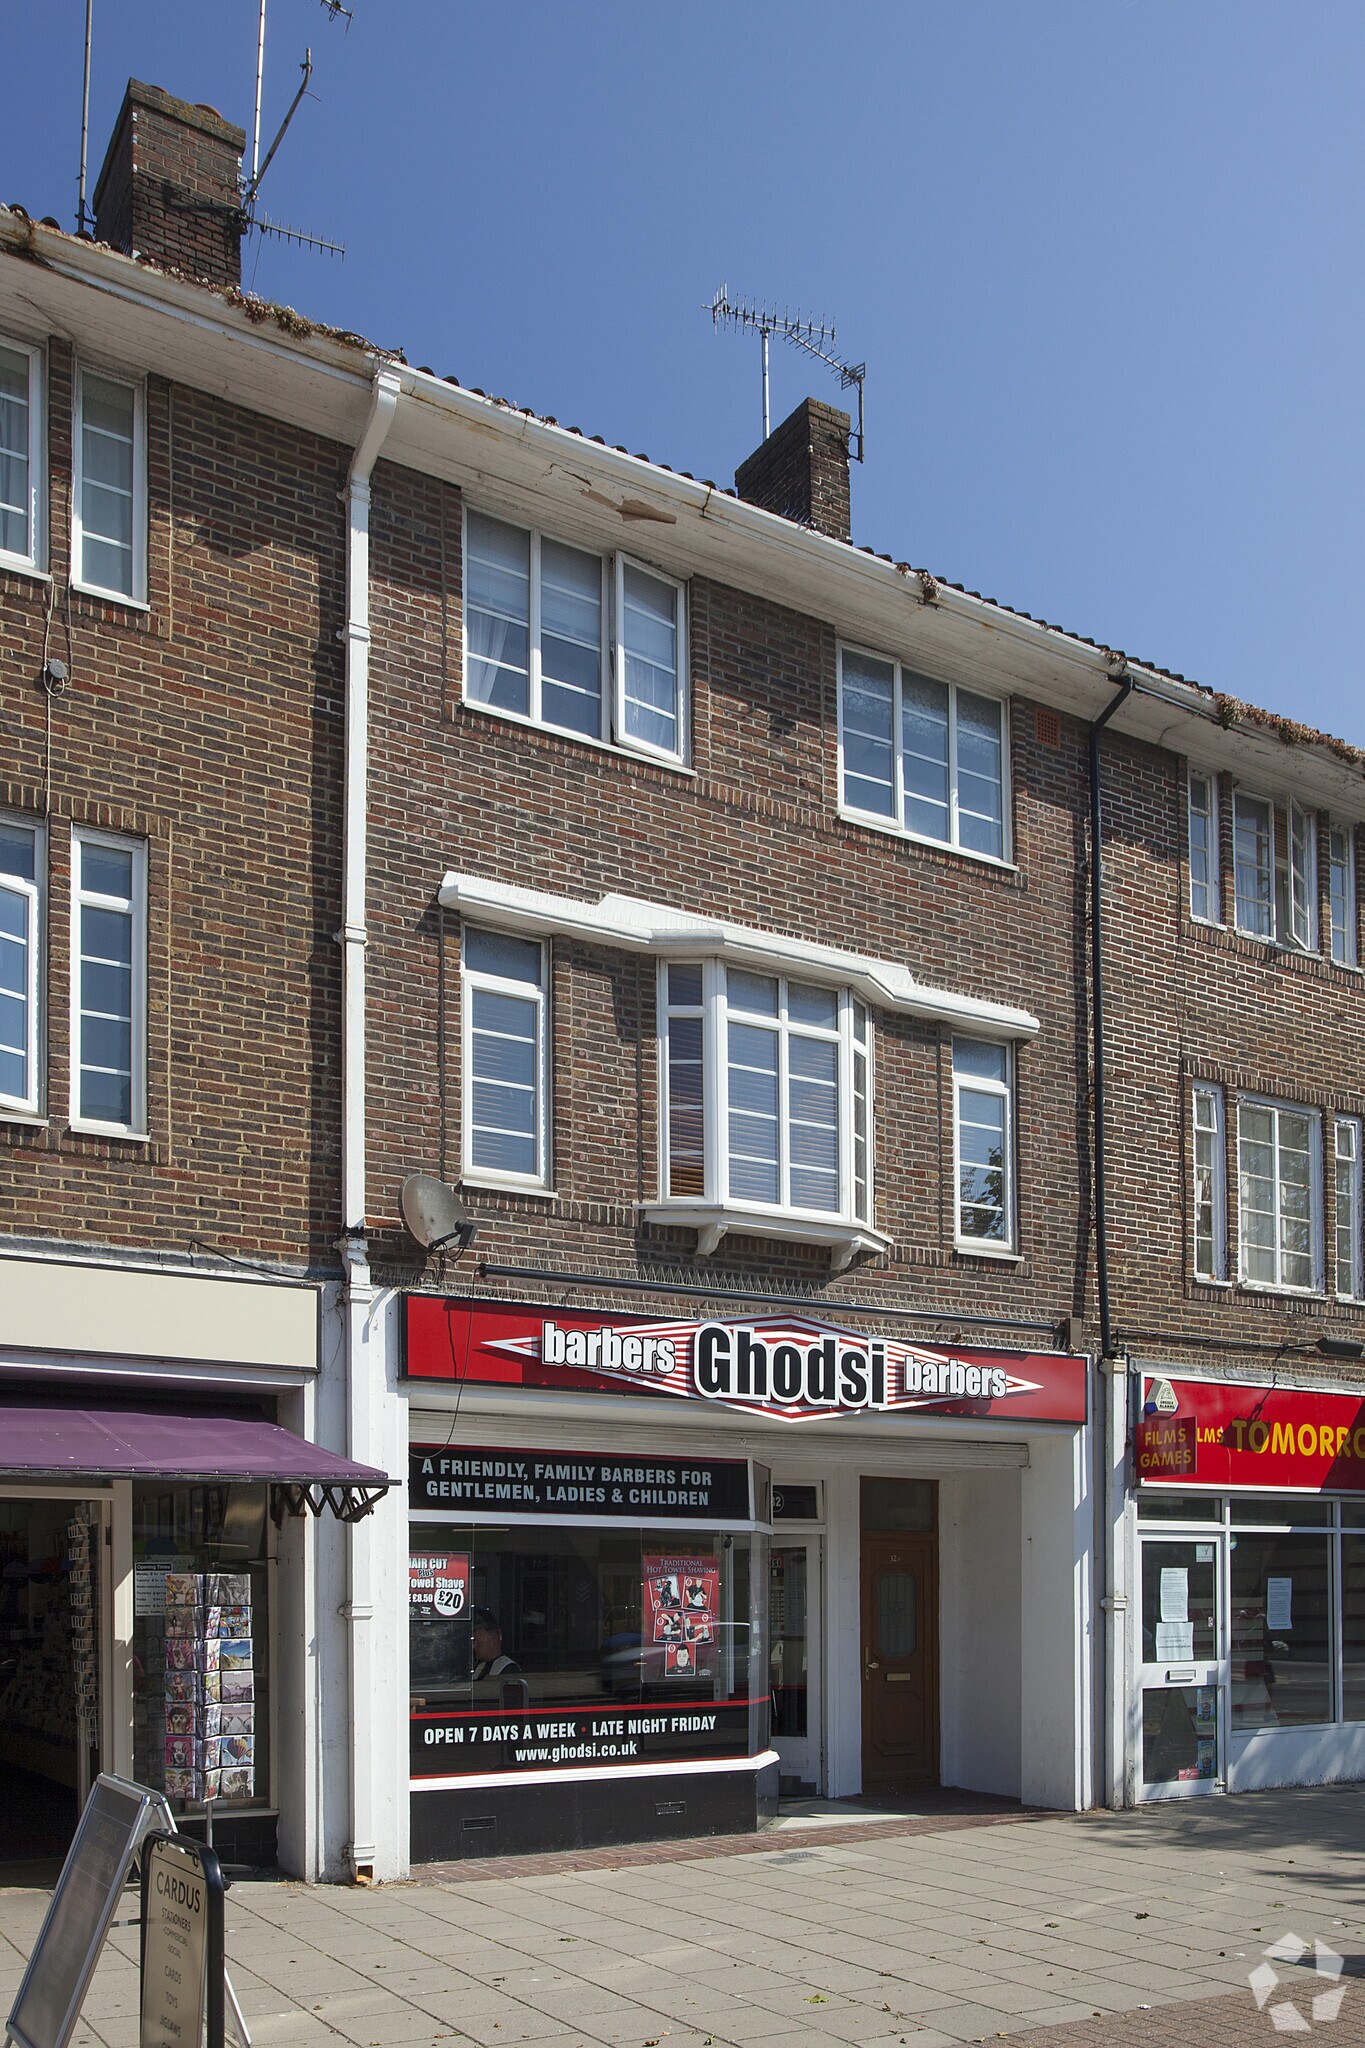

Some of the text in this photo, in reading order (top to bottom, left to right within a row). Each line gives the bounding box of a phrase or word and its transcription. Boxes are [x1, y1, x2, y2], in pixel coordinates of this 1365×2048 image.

[542, 1320, 676, 1374] barbers
[696, 1323, 887, 1407] Ghodsi
[904, 1355, 1007, 1398] barbers
[1145, 1427, 1187, 1446] FILMS
[1140, 1449, 1192, 1468] GAMES
[421, 1458, 712, 1486] A FRIENDLY, FAMILY BARBERS FOR
[426, 1480, 709, 1506] GENTLEMEN, LADIES & CHILDREN
[429, 1558, 447, 1570] CUT
[660, 1559, 704, 1567] TRADITIONAL
[664, 1566, 686, 1574] TOWEL
[687, 1566, 716, 1574] SHAVING
[436, 1577, 465, 1589] Shave
[439, 1591, 462, 1609] £20
[424, 1715, 716, 1745] OPEN 7 DAYS A WEEK LATE NIGHT FRIDAY
[515, 1740, 638, 1763] www.ghodsi.co.uk
[156, 1871, 200, 1914] CARDUS
[162, 1907, 191, 1932] STATIONERS
[165, 1965, 181, 1985] CARDS
